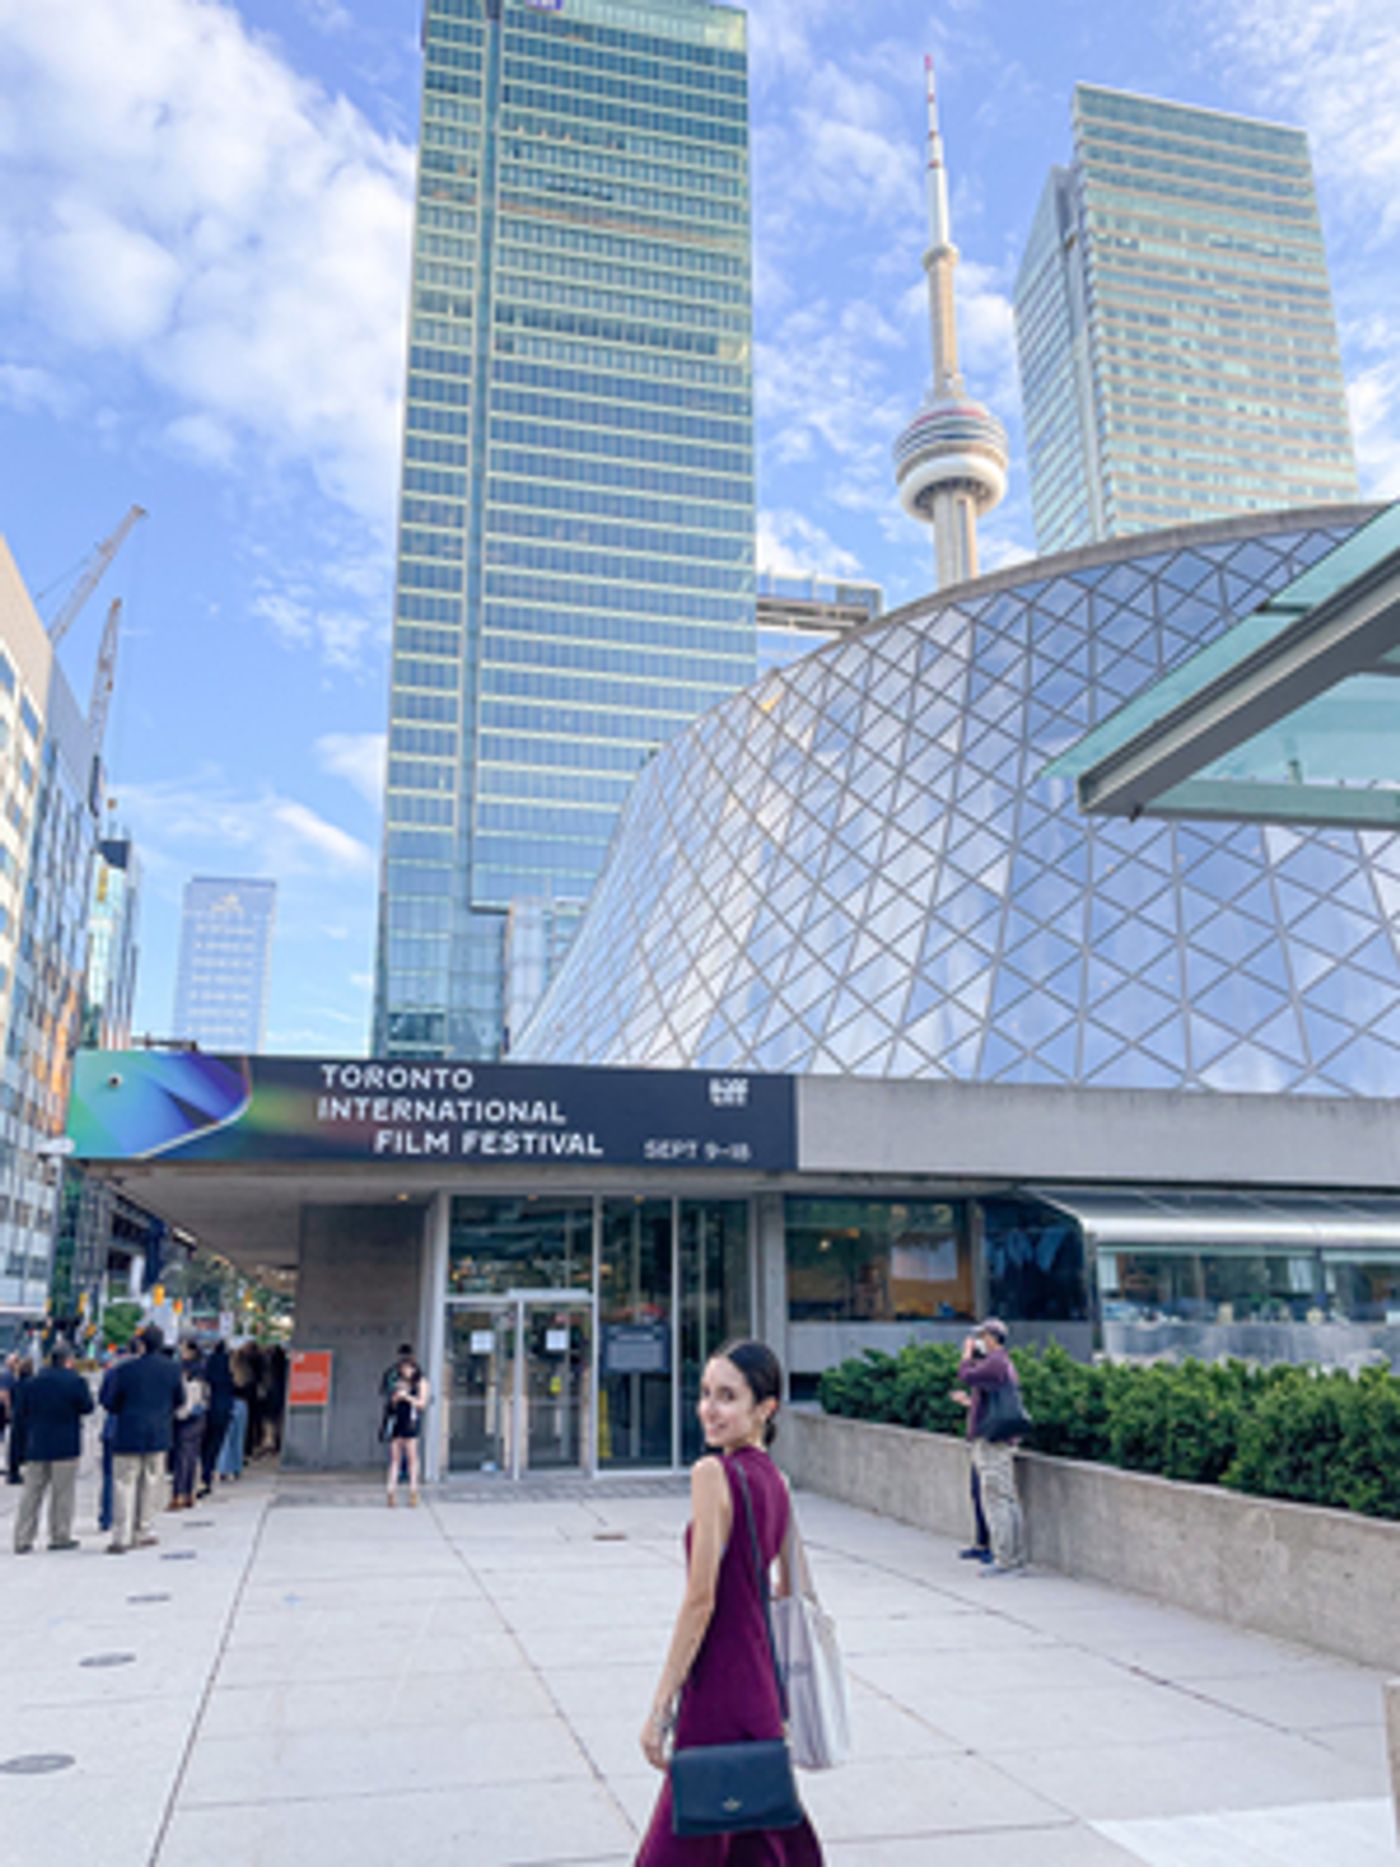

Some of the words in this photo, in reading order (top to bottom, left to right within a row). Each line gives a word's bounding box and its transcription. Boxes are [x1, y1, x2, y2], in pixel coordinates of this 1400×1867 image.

[320, 1063, 473, 1092] TORONTO
[317, 1096, 567, 1125] INTERNATIONAL
[374, 1129, 450, 1155] FILM
[460, 1130, 604, 1157] FESTIVAL
[643, 1139, 698, 1159] SEPT
